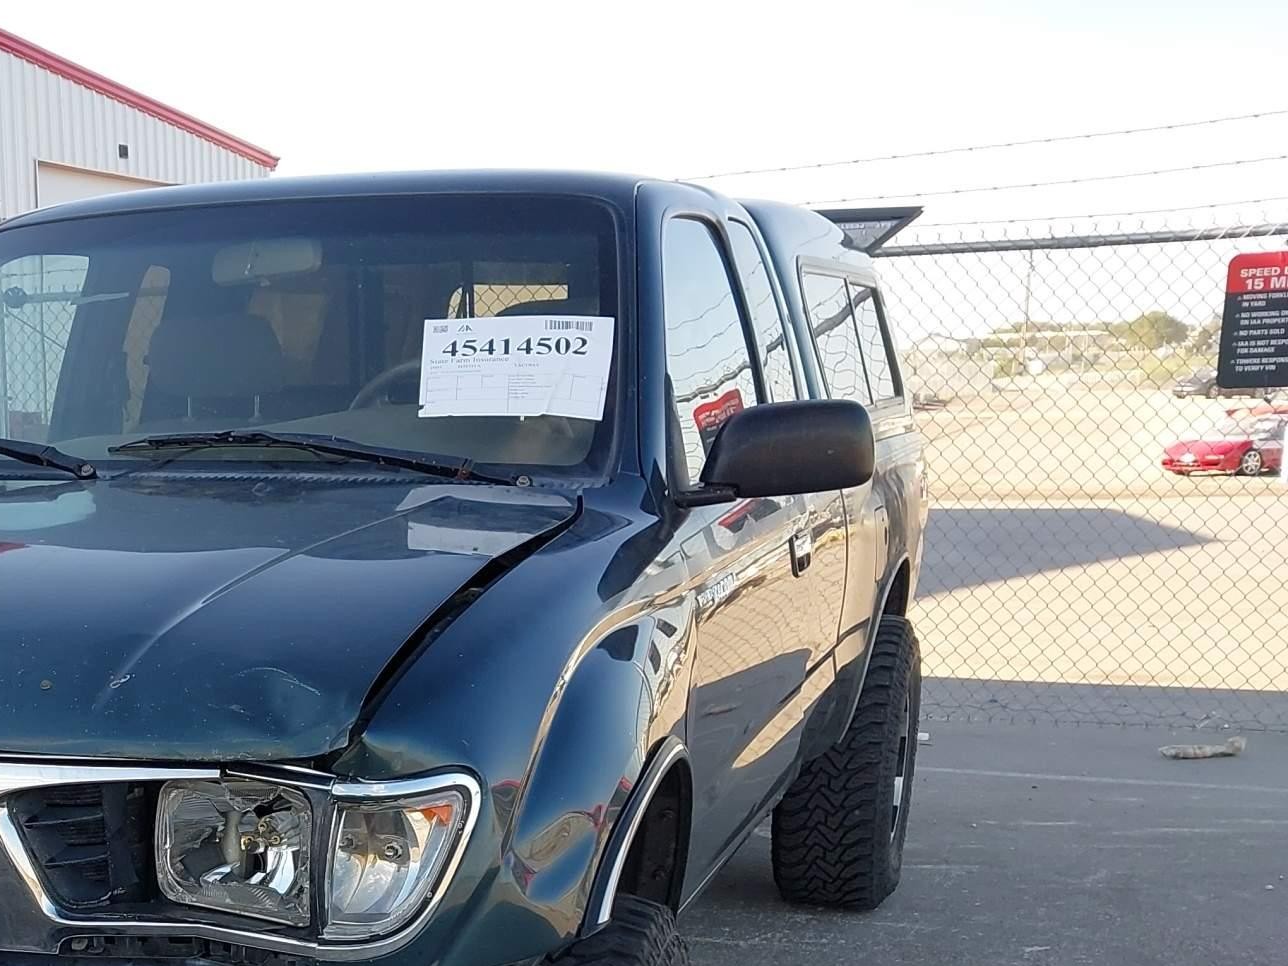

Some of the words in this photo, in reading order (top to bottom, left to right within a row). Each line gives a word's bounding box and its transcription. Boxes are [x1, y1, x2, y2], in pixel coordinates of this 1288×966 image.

[1240, 266, 1281, 278] SPEED
[1245, 278, 1264, 290] 15
[1270, 275, 1288, 289] M
[442, 336, 588, 357] 45414502
